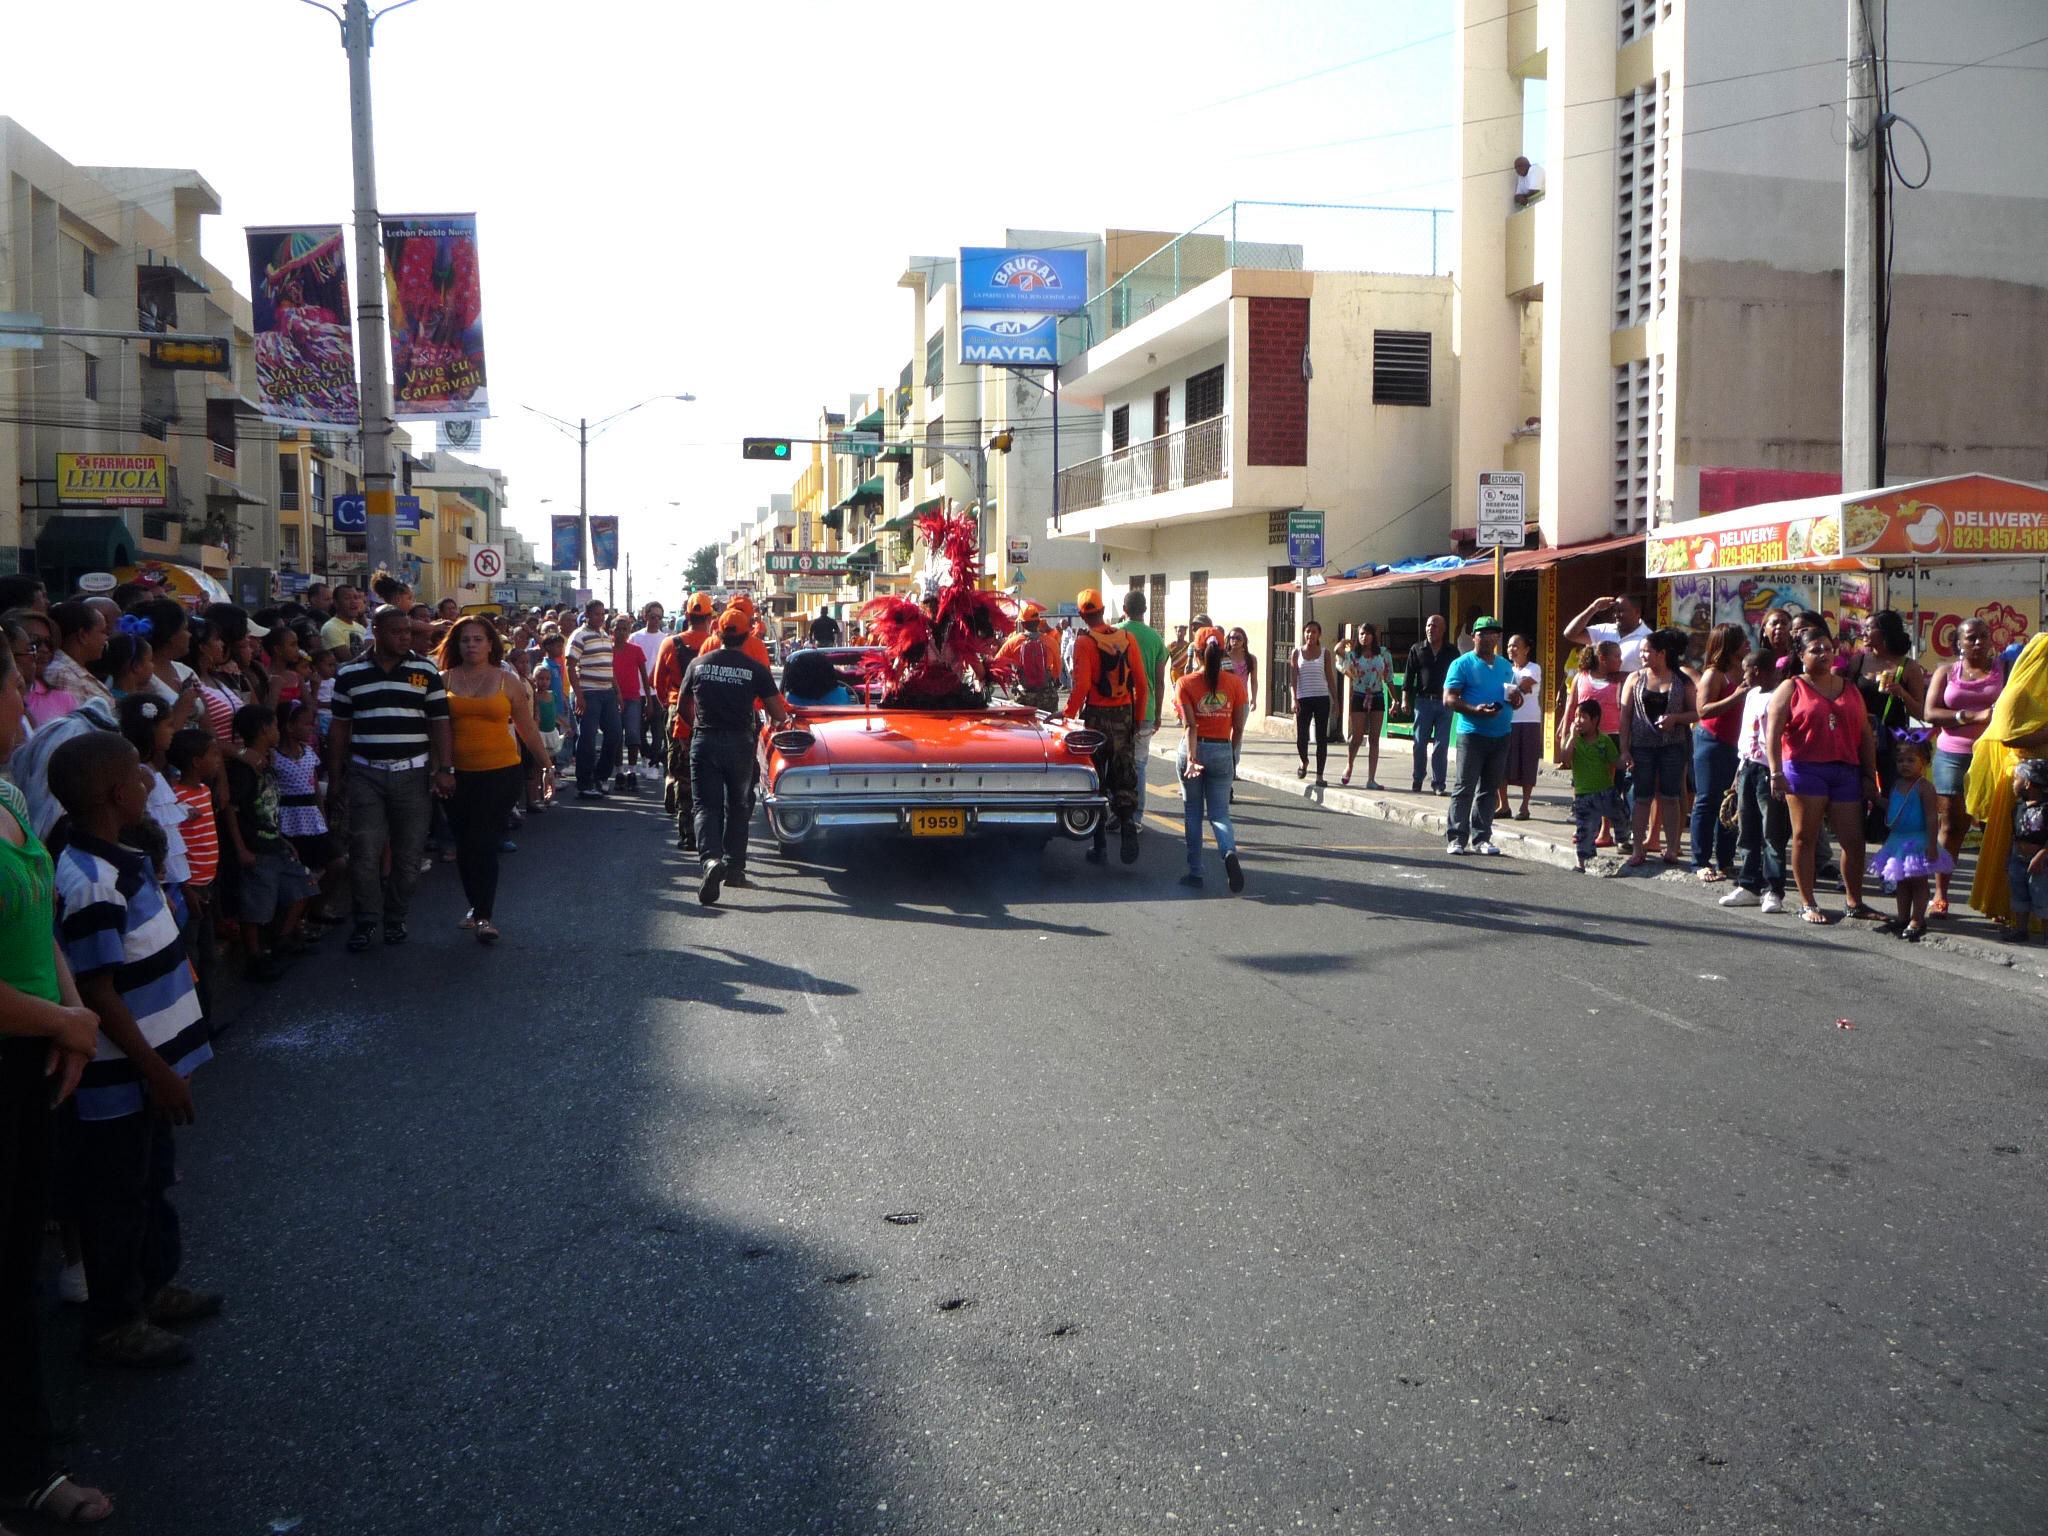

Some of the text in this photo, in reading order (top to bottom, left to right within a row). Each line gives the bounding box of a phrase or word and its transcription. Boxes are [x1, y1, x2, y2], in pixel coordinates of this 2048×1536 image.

[418, 228, 446, 236] Pueblo
[448, 228, 474, 236] Nuevo
[995, 258, 1057, 286] BRUGAL
[966, 346, 1052, 360] MAYRA
[270, 360, 340, 380] Vive tu
[405, 360, 469, 382] Vive tu
[266, 371, 353, 396] Carnaval!
[401, 370, 482, 400] Carnaval!
[833, 443, 864, 454] MELLA
[93, 457, 156, 470] FARMACIA
[66, 470, 160, 488] LETICIA
[1492, 476, 1520, 484] ESTACIONE
[1954, 512, 2042, 527] DELIVERY
[1720, 527, 1774, 546] DELIVERY
[1720, 541, 1784, 568] 829-857-5131
[772, 556, 794, 570] OUT
[1802, 576, 1814, 584] EN
[701, 674, 744, 686] DEFENSA CIVIL
[918, 816, 958, 828] 1959
